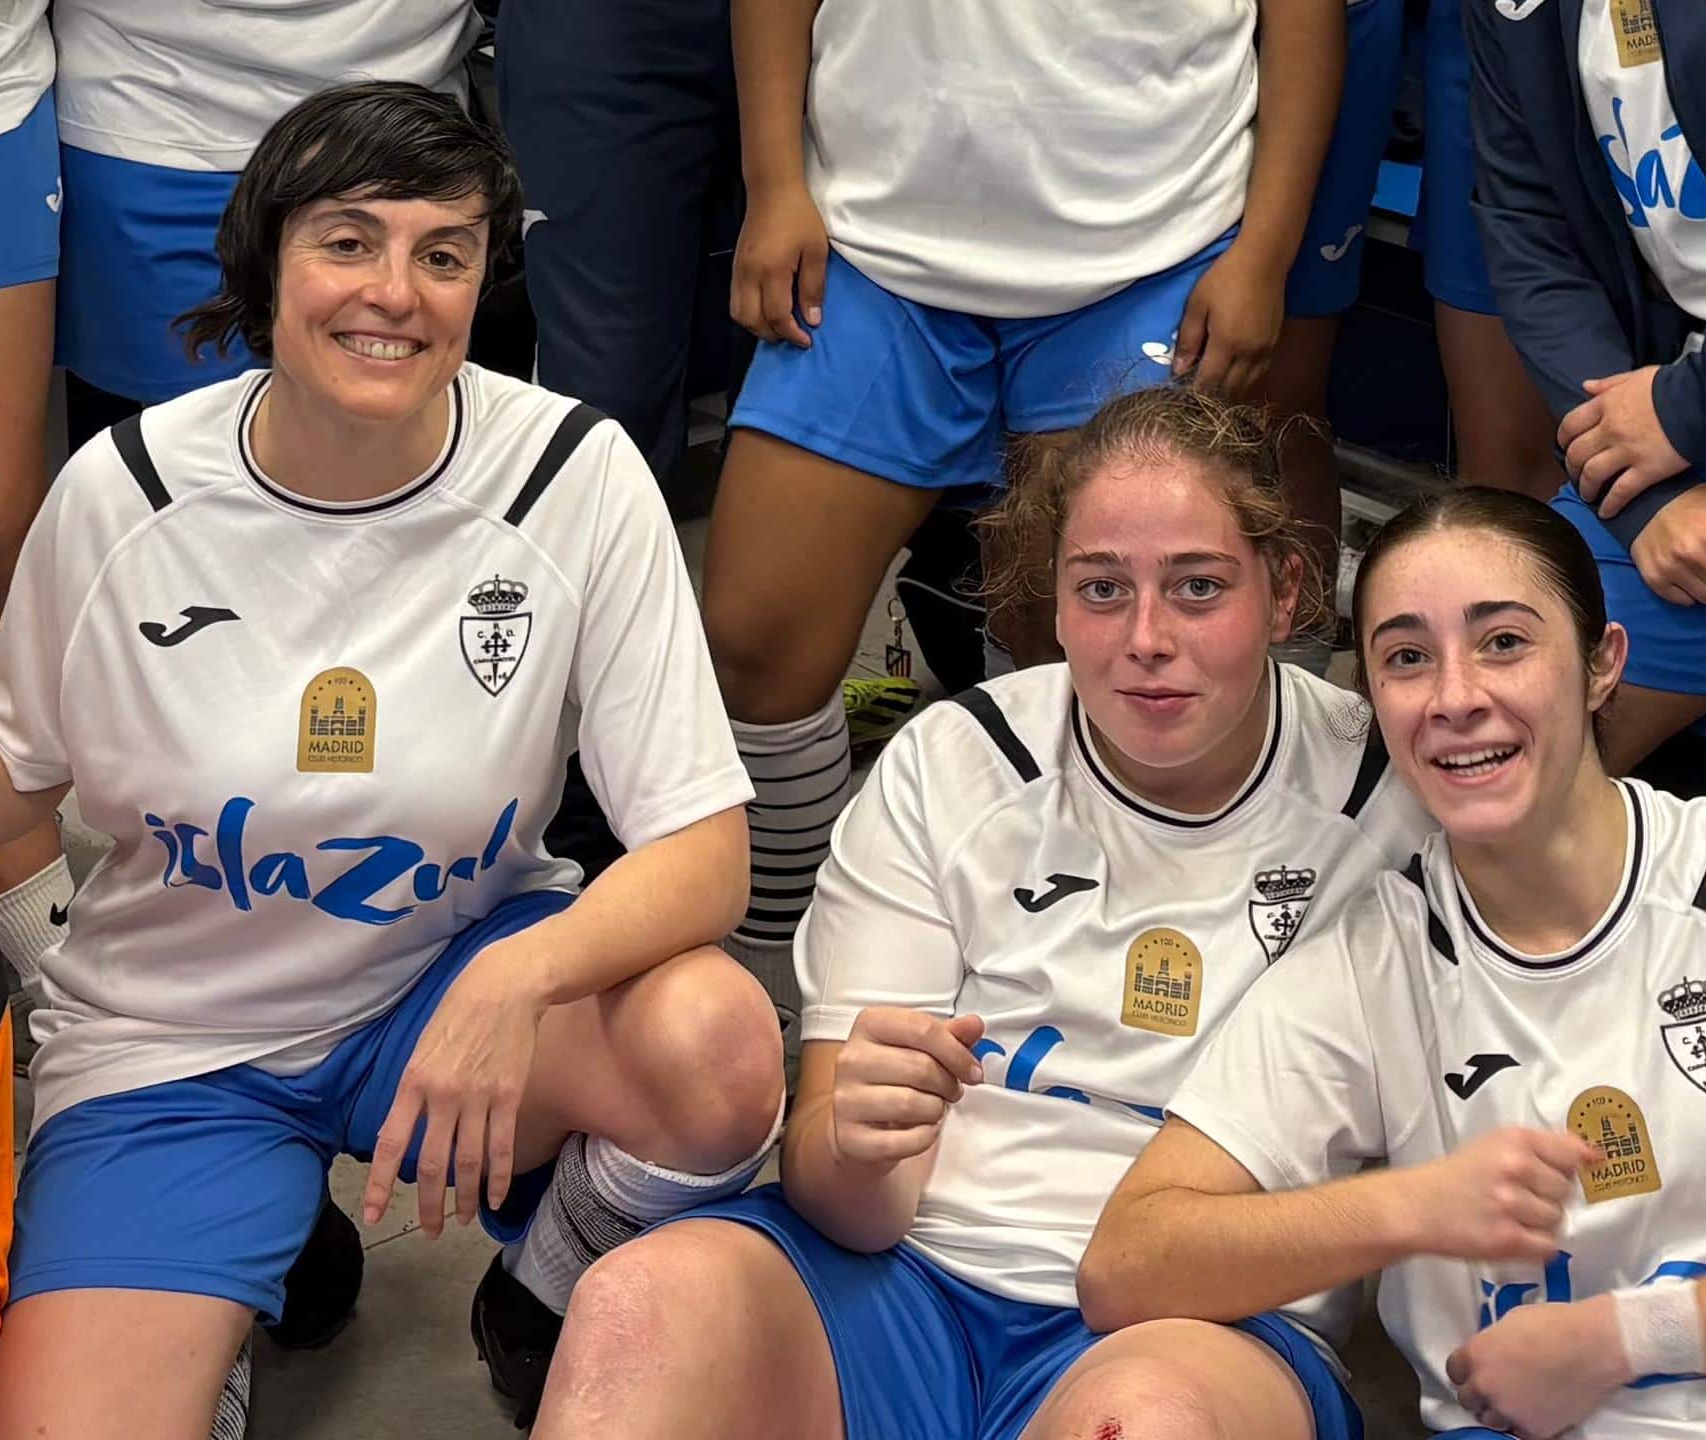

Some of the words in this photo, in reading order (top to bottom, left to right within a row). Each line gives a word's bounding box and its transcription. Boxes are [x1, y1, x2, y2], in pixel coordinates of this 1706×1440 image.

[308, 740, 365, 754] MADRID
[144, 795, 520, 926] islaZul
[1132, 997, 1190, 1018] MADRID
[1591, 1159, 1647, 1183] MADRID
